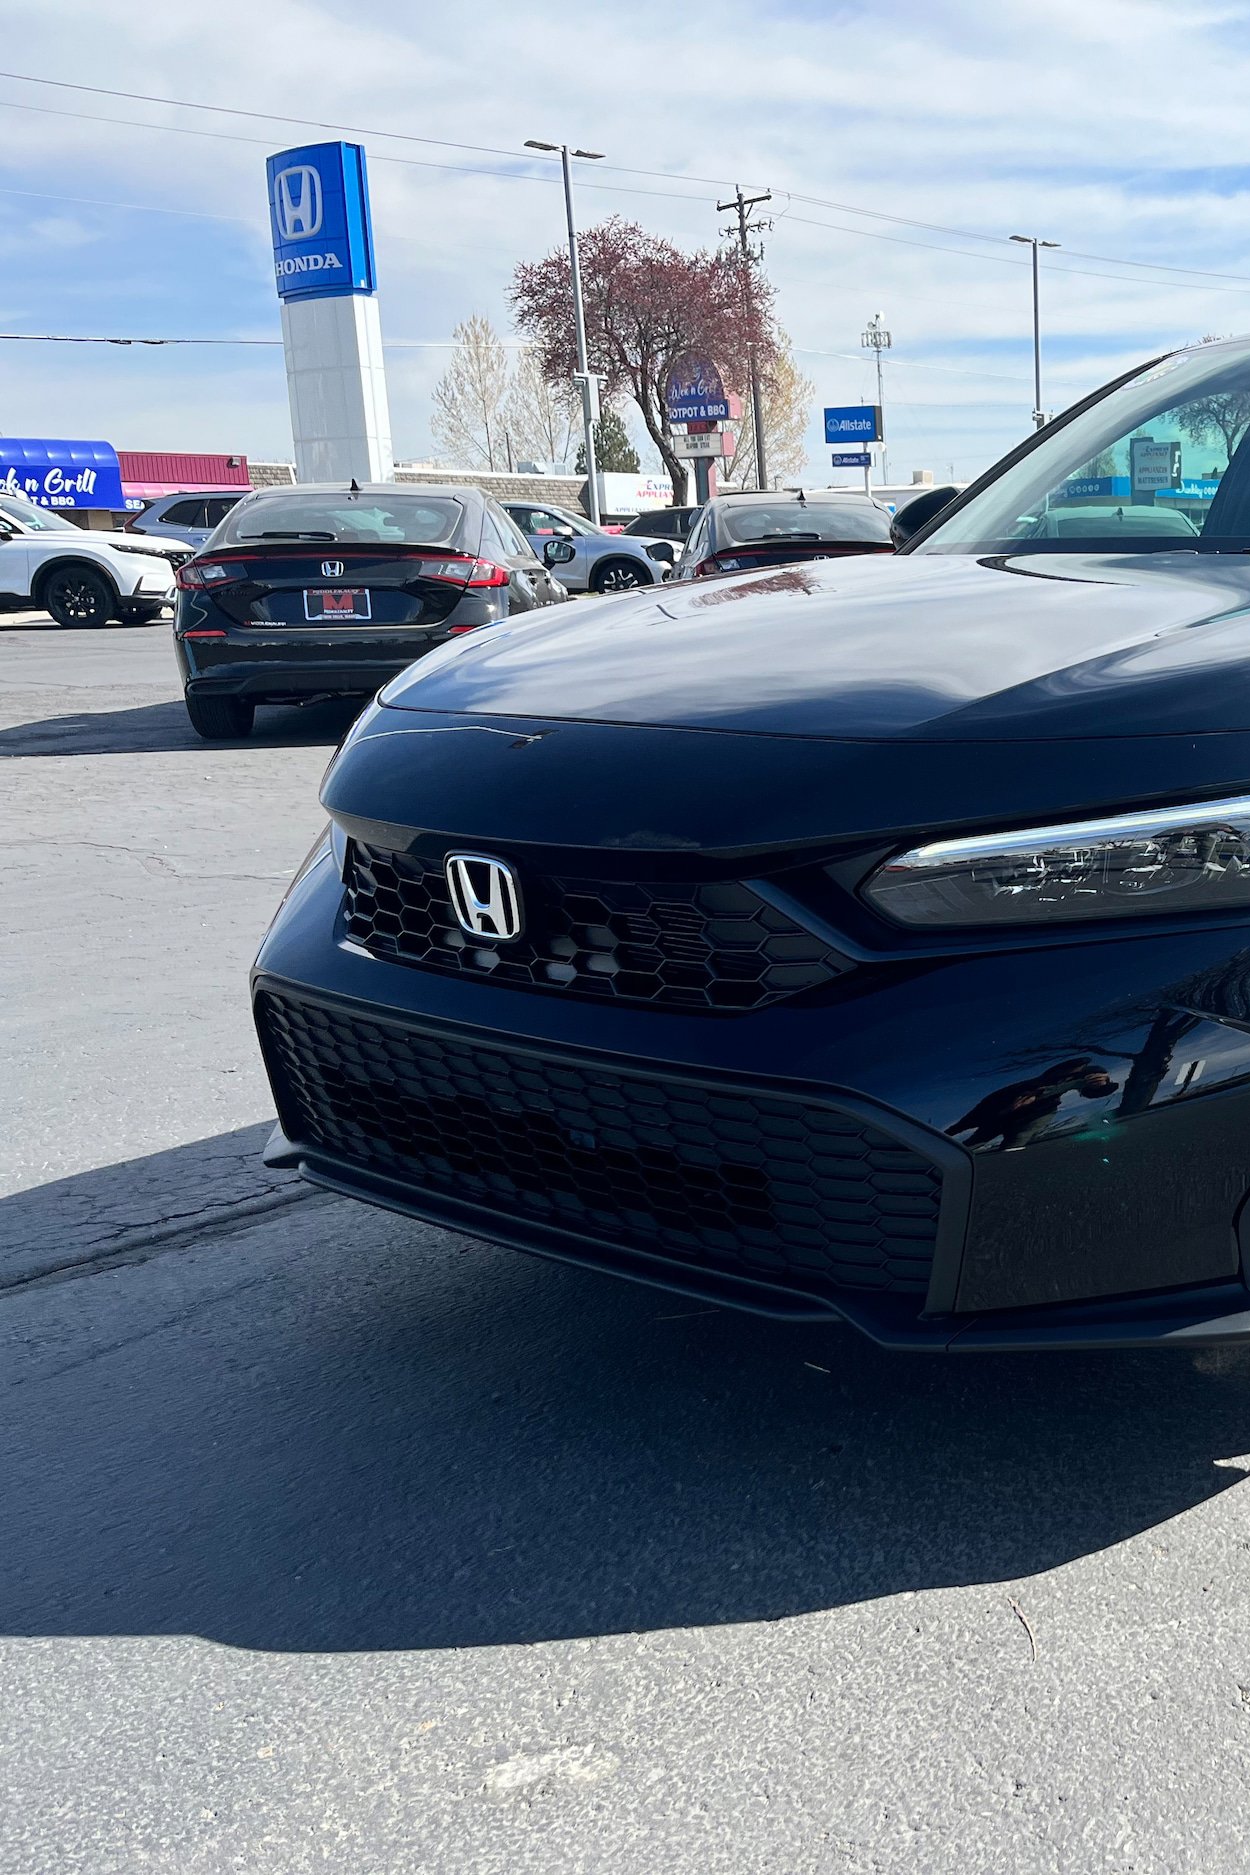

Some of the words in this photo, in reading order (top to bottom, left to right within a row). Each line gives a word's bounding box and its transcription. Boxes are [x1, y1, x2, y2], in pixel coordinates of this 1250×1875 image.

[275, 253, 343, 277] HONDA
[700, 405, 706, 417] &
[707, 404, 725, 416] BBQ
[839, 419, 872, 431] Allstate
[25, 478, 39, 492] n
[44, 467, 97, 495] Grill
[636, 490, 674, 498] APPLIAN
[40, 496, 49, 506] &
[51, 496, 75, 506] BBQ
